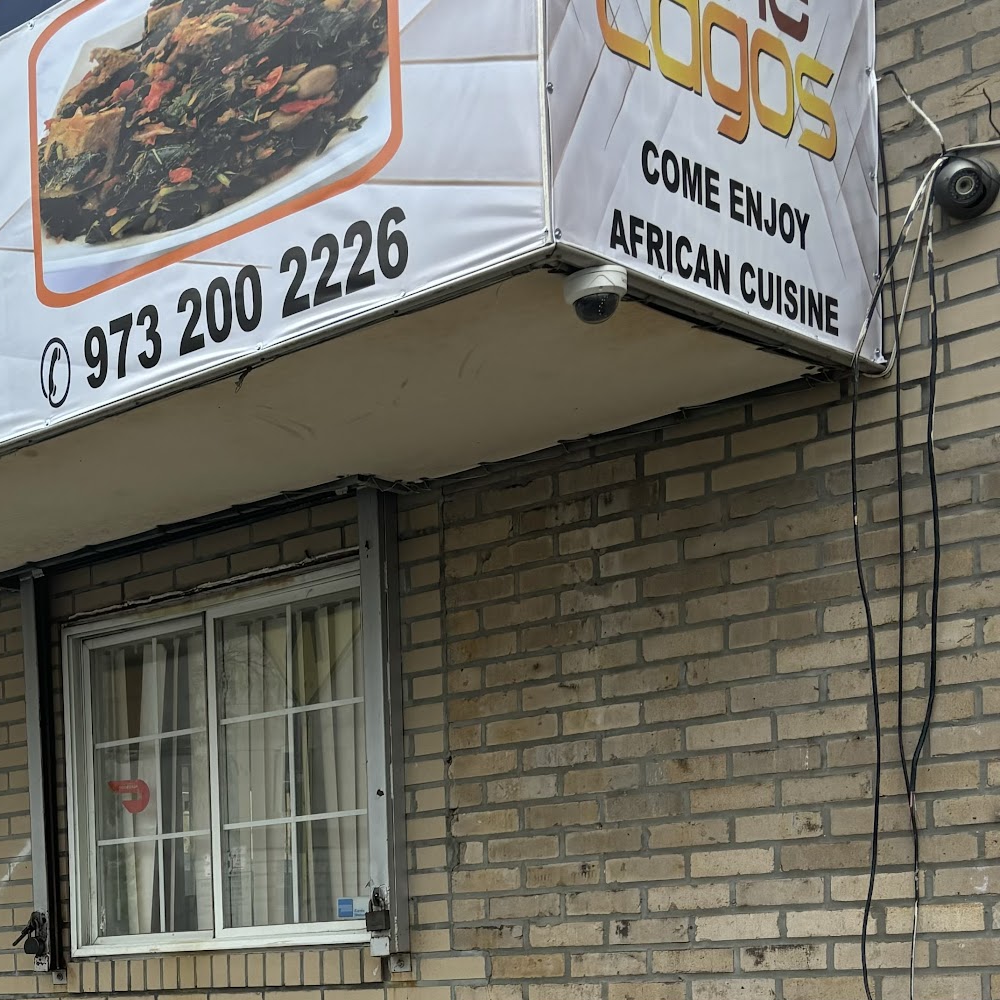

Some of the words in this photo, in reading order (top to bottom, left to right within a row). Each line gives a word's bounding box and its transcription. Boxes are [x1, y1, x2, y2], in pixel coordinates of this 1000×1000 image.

[596, 0, 837, 162] Lagos
[641, 140, 720, 213] COME
[729, 178, 810, 250] ENJOY
[84, 304, 162, 389] 973
[177, 264, 263, 357] 200
[279, 206, 409, 318] 2226
[609, 208, 730, 295] AFRICAN
[739, 262, 839, 336] CUISINE
